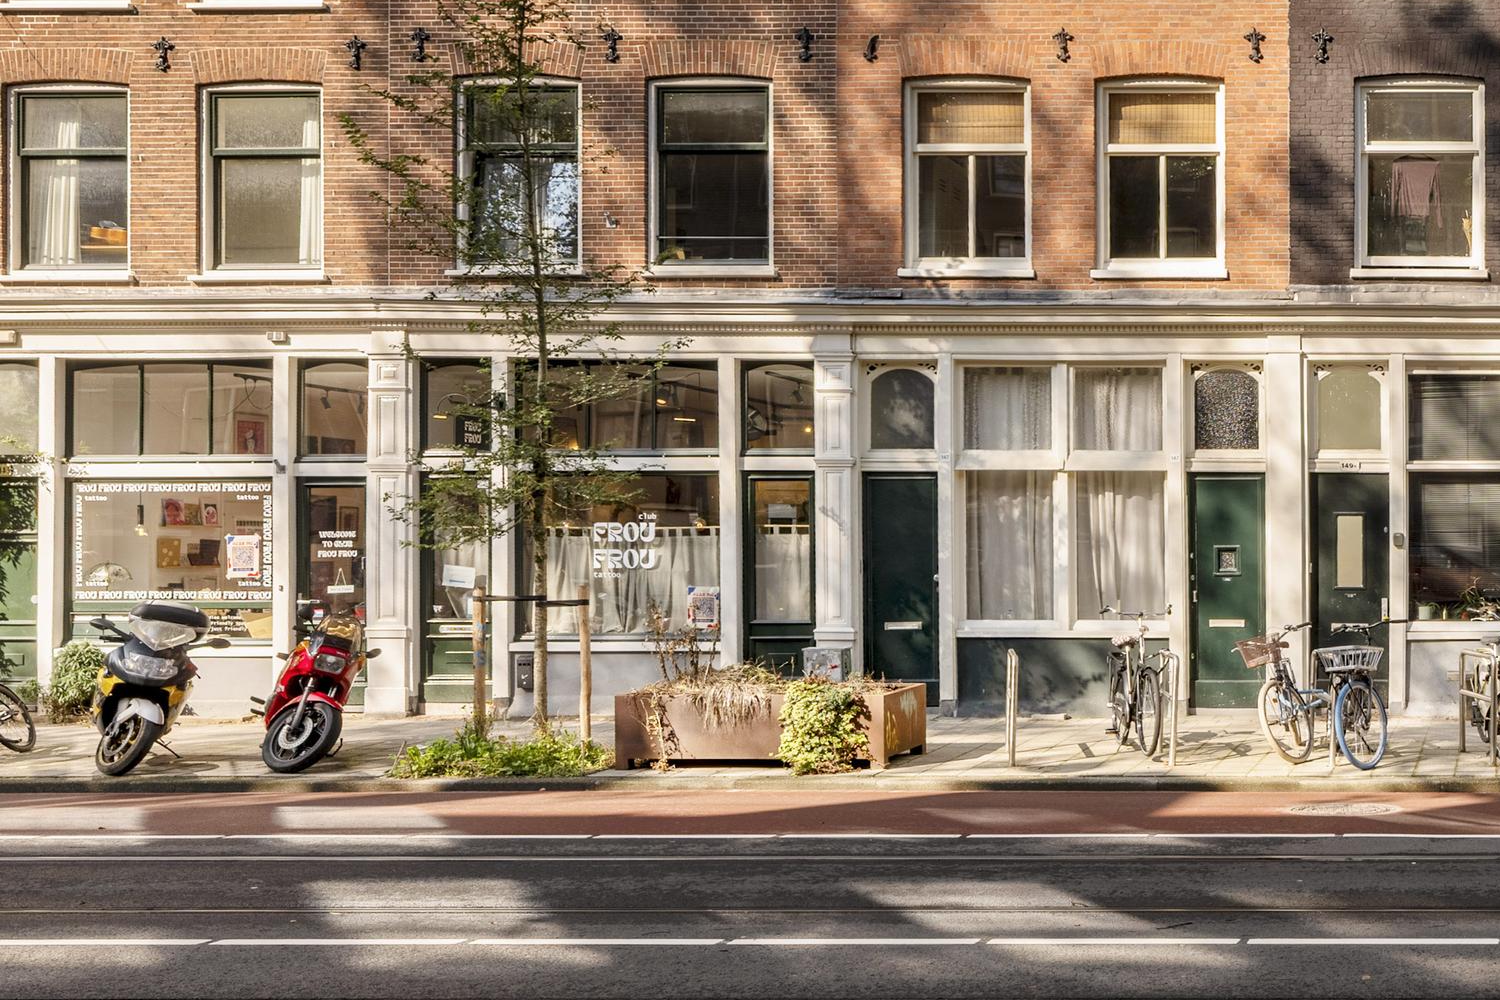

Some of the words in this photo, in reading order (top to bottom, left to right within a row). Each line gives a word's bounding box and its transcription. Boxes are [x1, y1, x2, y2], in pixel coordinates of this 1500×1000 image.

[464, 433, 482, 444] FROU
[98, 483, 122, 492] FROU
[123, 483, 146, 492] FROU
[148, 483, 171, 492] FROU
[172, 483, 196, 492] FROU
[197, 483, 221, 492] FROU
[222, 483, 246, 492] FROU
[247, 483, 271, 492] FROU
[263, 495, 272, 517] FROU
[638, 512, 657, 520] club
[263, 518, 272, 541] FROU
[593, 522, 656, 542] FROU
[263, 541, 272, 564] FROU
[317, 550, 337, 558] FROU
[338, 550, 358, 558] FROU
[593, 549, 656, 569] FROU
[263, 564, 272, 587] FROU
[75, 591, 97, 599] FROU
[98, 591, 122, 599] FROU
[123, 591, 147, 599] FROU
[148, 591, 172, 599] FROU
[172, 591, 197, 599] FROU
[197, 591, 222, 599] FROU
[223, 591, 247, 599] FROU
[247, 591, 272, 599] FROU
